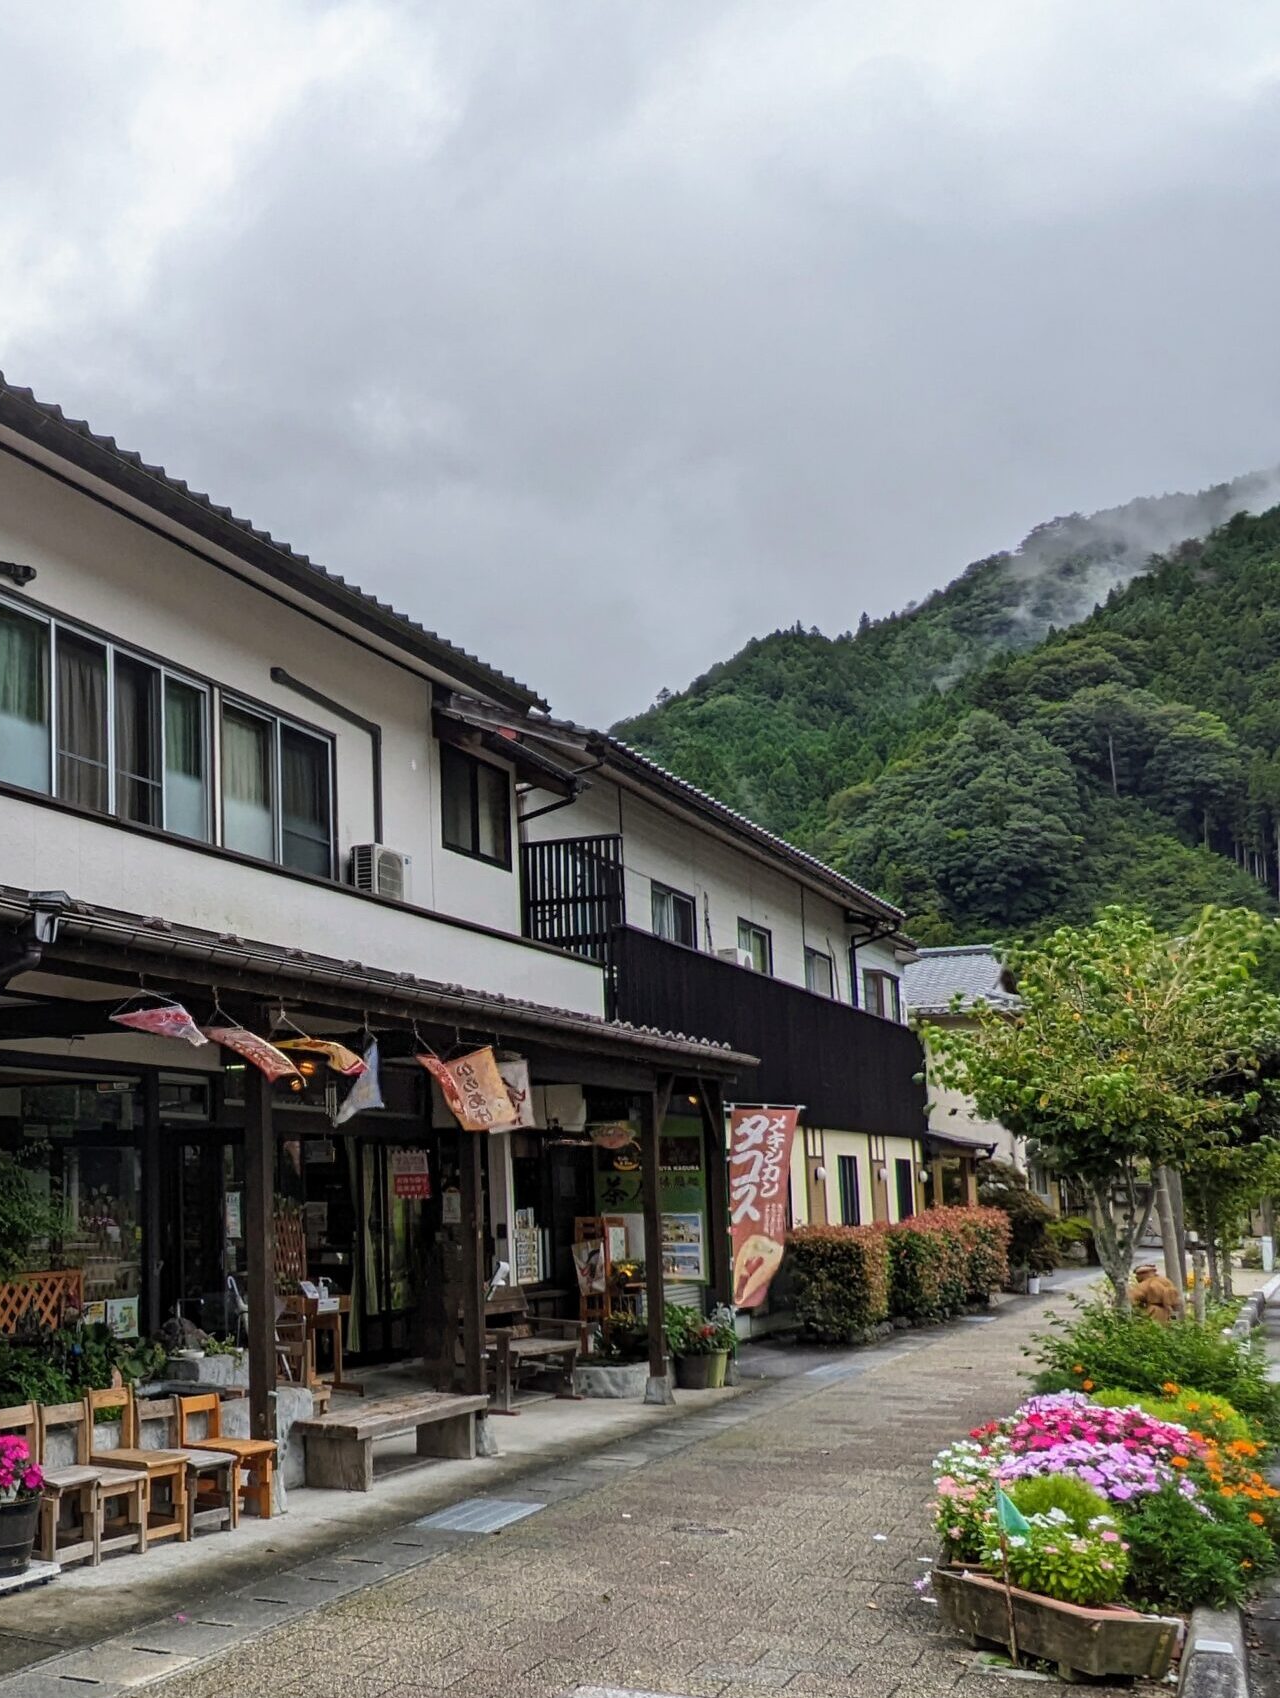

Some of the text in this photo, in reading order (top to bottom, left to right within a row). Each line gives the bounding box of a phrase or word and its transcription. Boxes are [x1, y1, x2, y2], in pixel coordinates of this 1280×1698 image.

[730, 1114, 770, 1224] タコス
[760, 1115, 784, 1198] メキシカン
